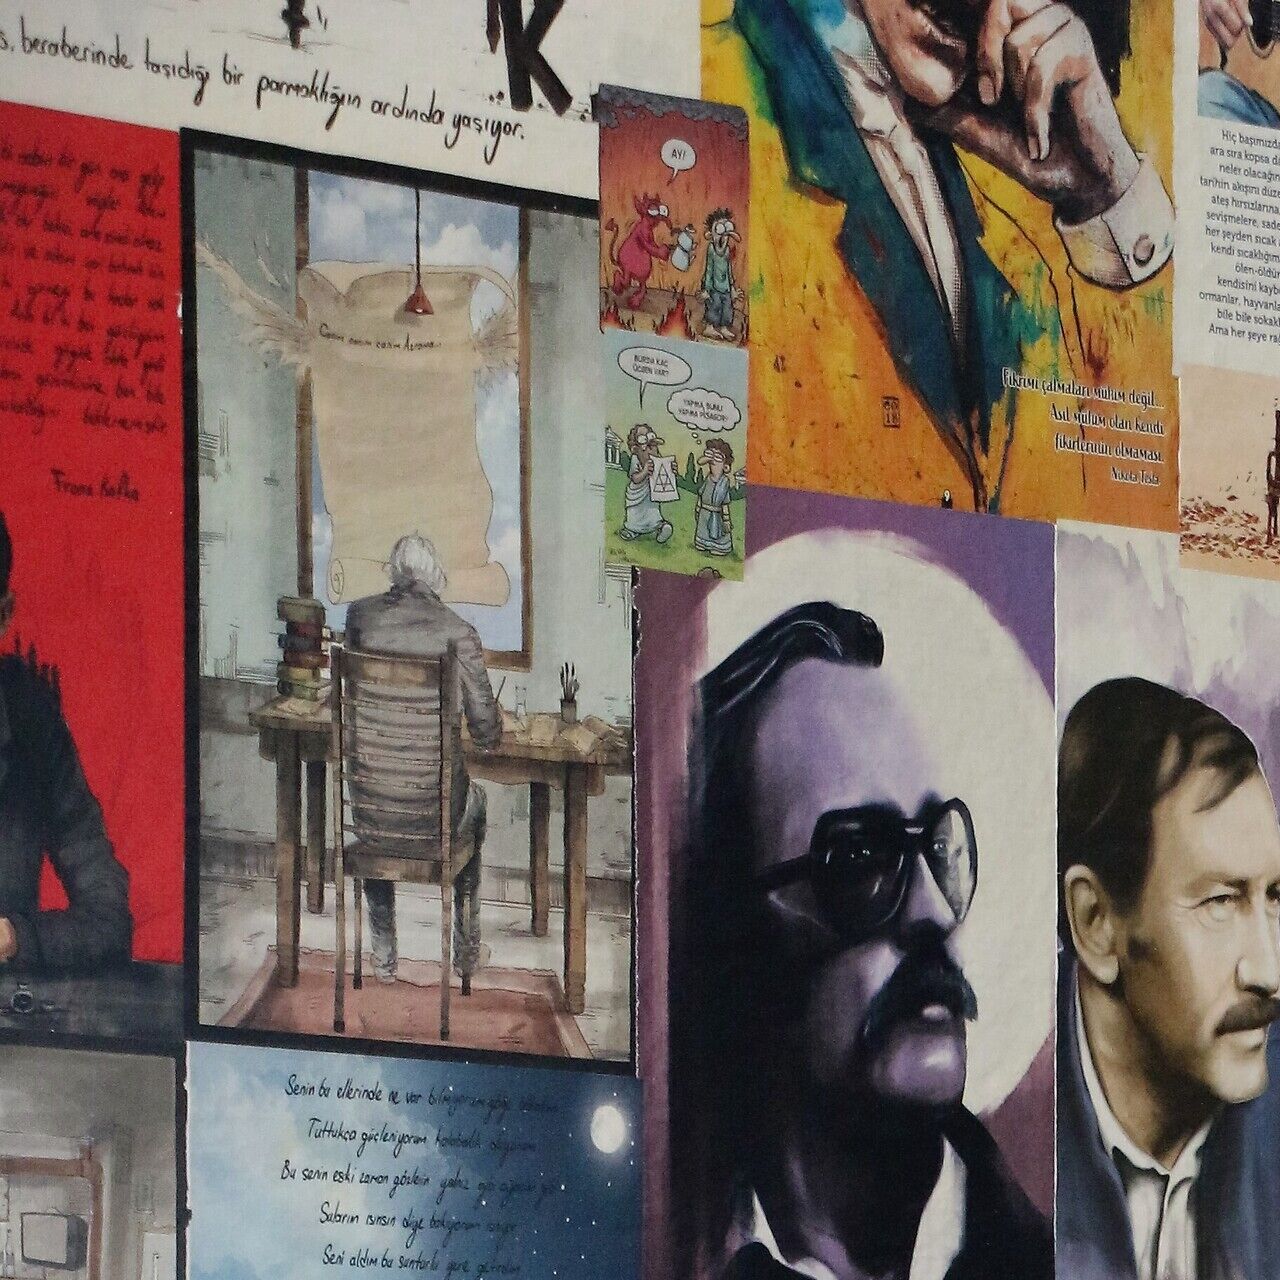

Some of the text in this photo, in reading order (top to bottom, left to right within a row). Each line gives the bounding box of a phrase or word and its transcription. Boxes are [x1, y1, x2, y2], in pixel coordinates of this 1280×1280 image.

[19, 16, 525, 165] beraberinde taşıdığı bir parmaklığın ardında yaşıyor.
[1232, 326, 1246, 337] her
